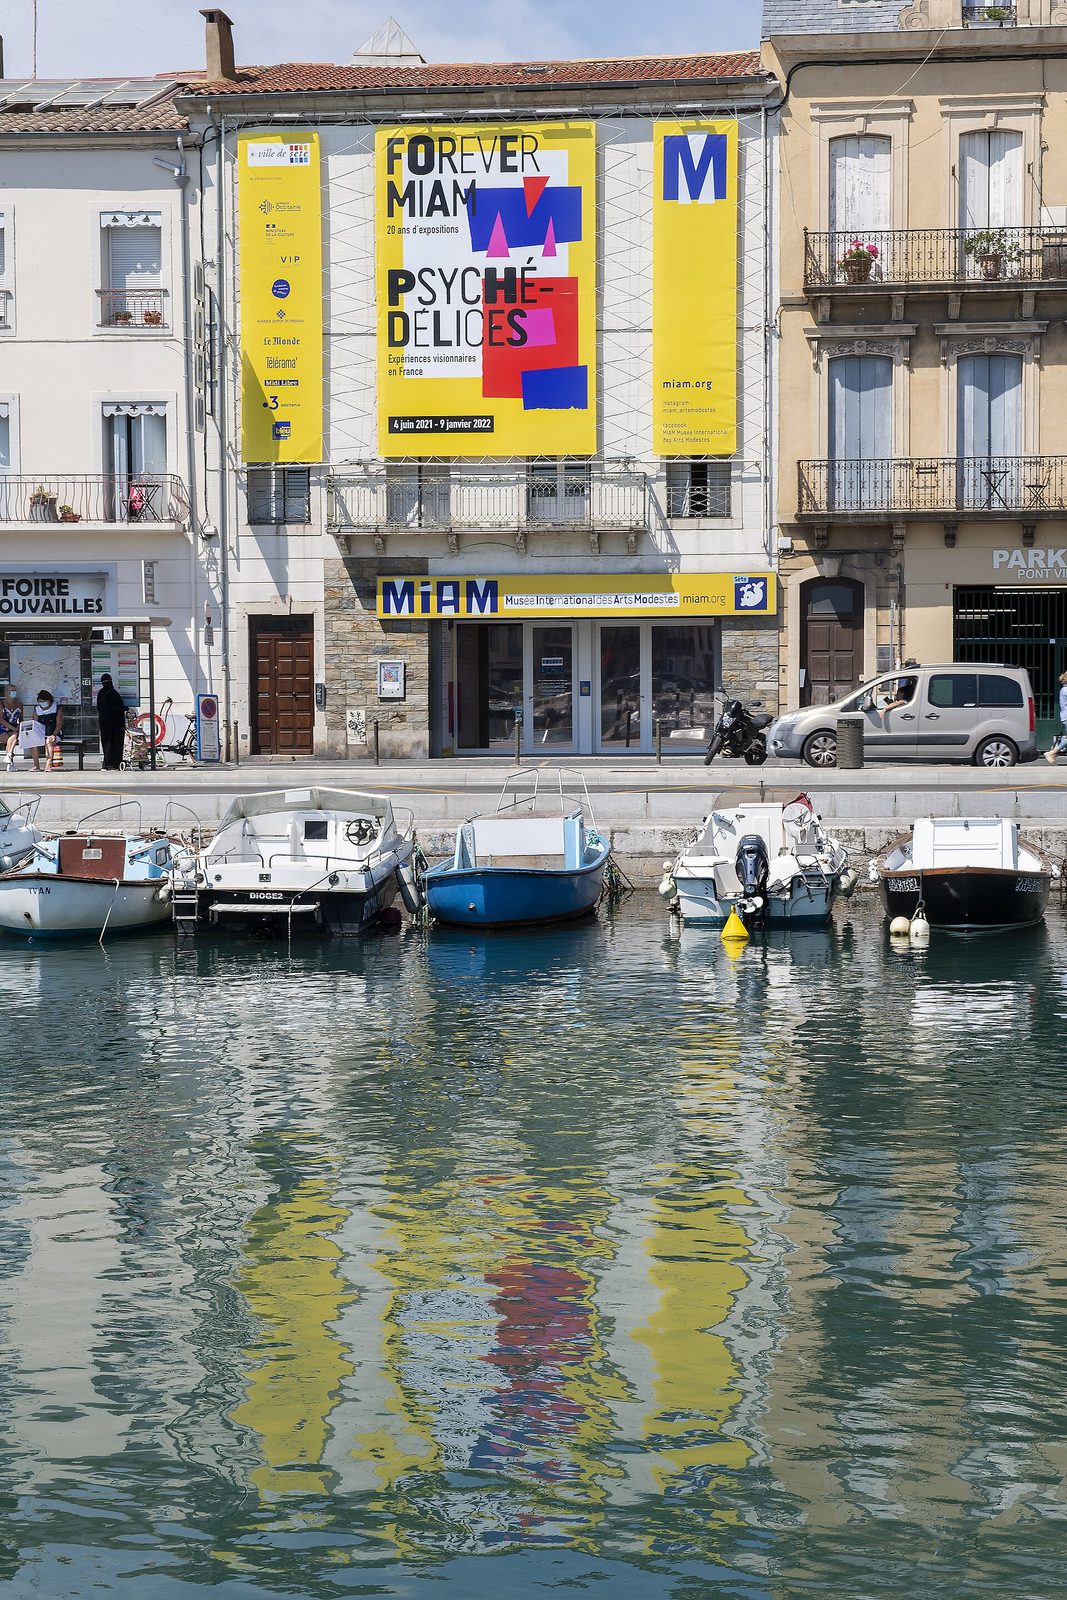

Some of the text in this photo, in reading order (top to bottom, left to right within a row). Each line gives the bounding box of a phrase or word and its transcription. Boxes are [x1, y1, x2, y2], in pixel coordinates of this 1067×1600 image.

[258, 148, 276, 158] ville
[276, 148, 287, 158] de
[386, 134, 541, 176] FOREVER
[663, 133, 727, 201] M
[387, 179, 477, 218] MIAM
[386, 224, 459, 236] 20 ans d'expositions
[387, 257, 554, 307] PSYCHÉ-
[387, 308, 529, 348] DÉLICES
[263, 335, 301, 346] Le Monde
[388, 352, 477, 365] Expériences visionnaires
[388, 366, 424, 376] en France
[662, 379, 713, 391] miam.org
[393, 419, 400, 429] 4
[400, 419, 415, 431] juin
[415, 419, 433, 429] 2021
[440, 419, 445, 429] 9
[446, 418, 473, 431] janvier
[473, 418, 492, 429] 2022
[992, 548, 1067, 569] PARK
[1017, 568, 1067, 579] PONT VI
[2, 578, 70, 597] FOIRE
[0, 598, 103, 614] OUVAILLES
[505, 592, 726, 607] Musée International des Arts Modestes miam.org
[27, 886, 52, 895] YVAN
